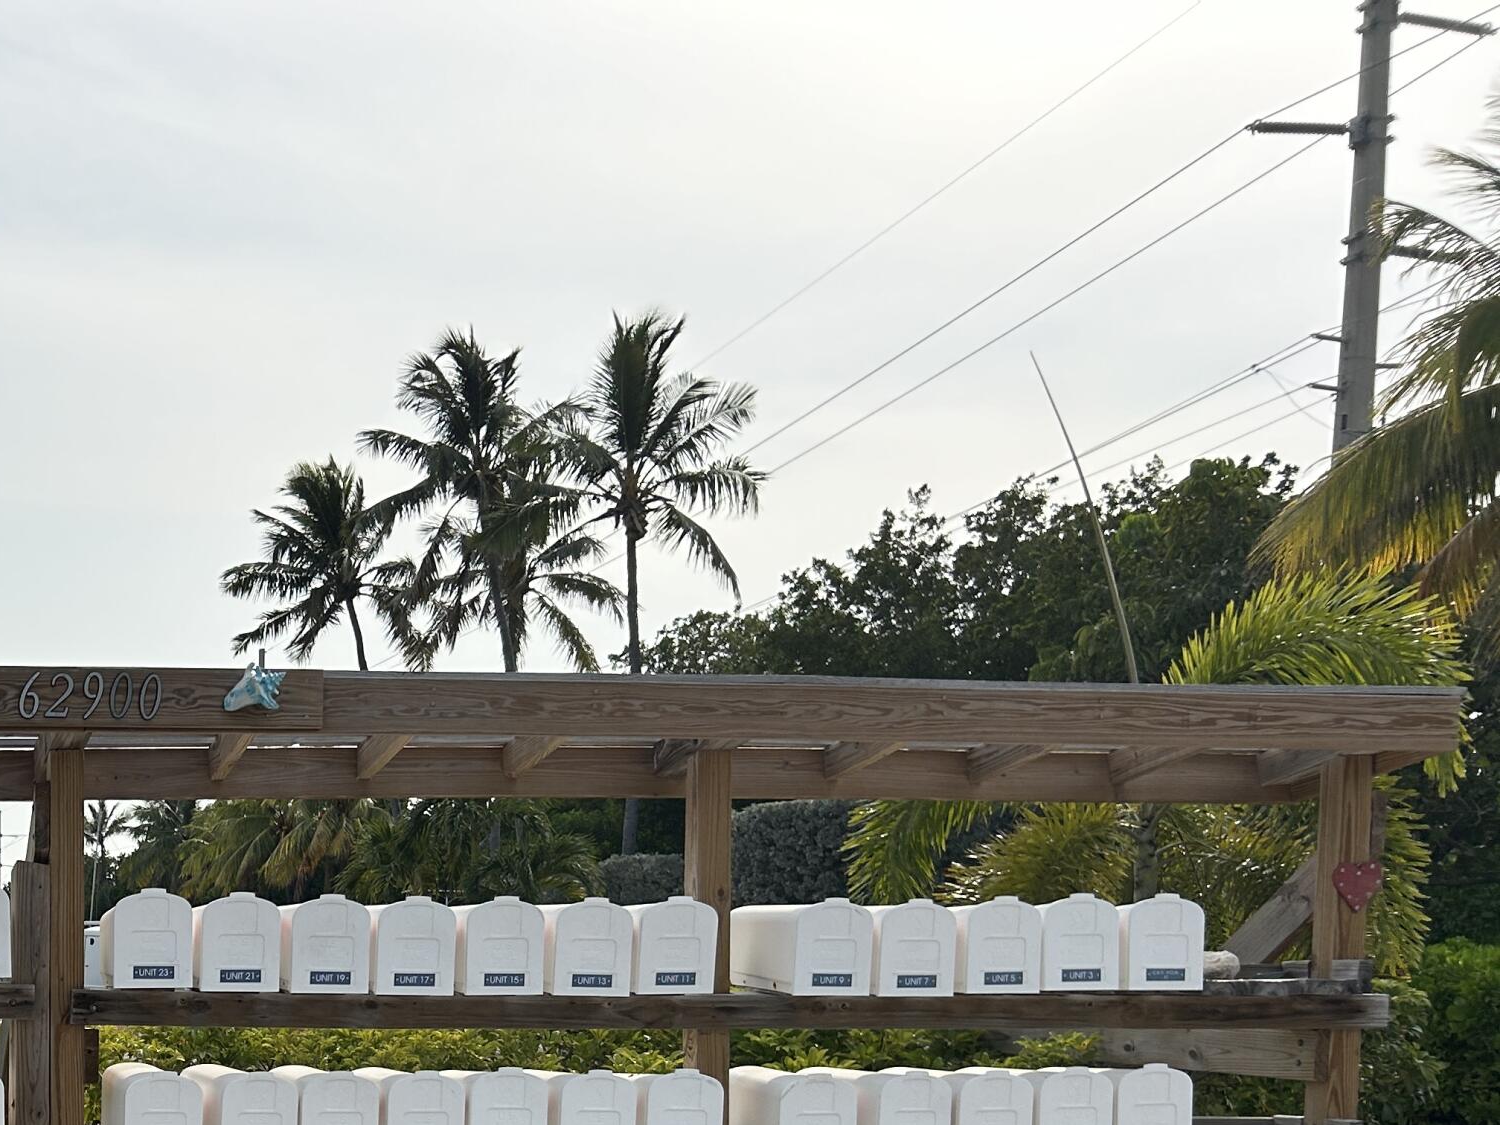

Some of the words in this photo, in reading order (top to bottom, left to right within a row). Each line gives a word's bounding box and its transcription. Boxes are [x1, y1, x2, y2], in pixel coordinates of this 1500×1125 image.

[18, 671, 162, 721] 62900
[139, 968, 157, 977] UNIT
[158, 968, 169, 977] 23
[225, 971, 244, 980] UNIT
[245, 972, 255, 980] 21
[1069, 971, 1087, 980] UNIT
[315, 974, 334, 982] UNIT
[336, 974, 346, 982] 19
[399, 975, 418, 984] UNIT
[420, 976, 430, 984] 17
[489, 975, 508, 984] UNIT
[510, 975, 520, 984] 15
[577, 976, 595, 985] UNIT
[598, 977, 607, 985] 13
[661, 974, 679, 983] UNIT
[681, 975, 690, 983] 11
[820, 976, 838, 984] UNIT
[838, 976, 845, 984] 9
[904, 977, 923, 986] UNIT
[924, 977, 929, 985] 7
[992, 974, 1009, 983] UNIT
[1010, 974, 1016, 982] 5
